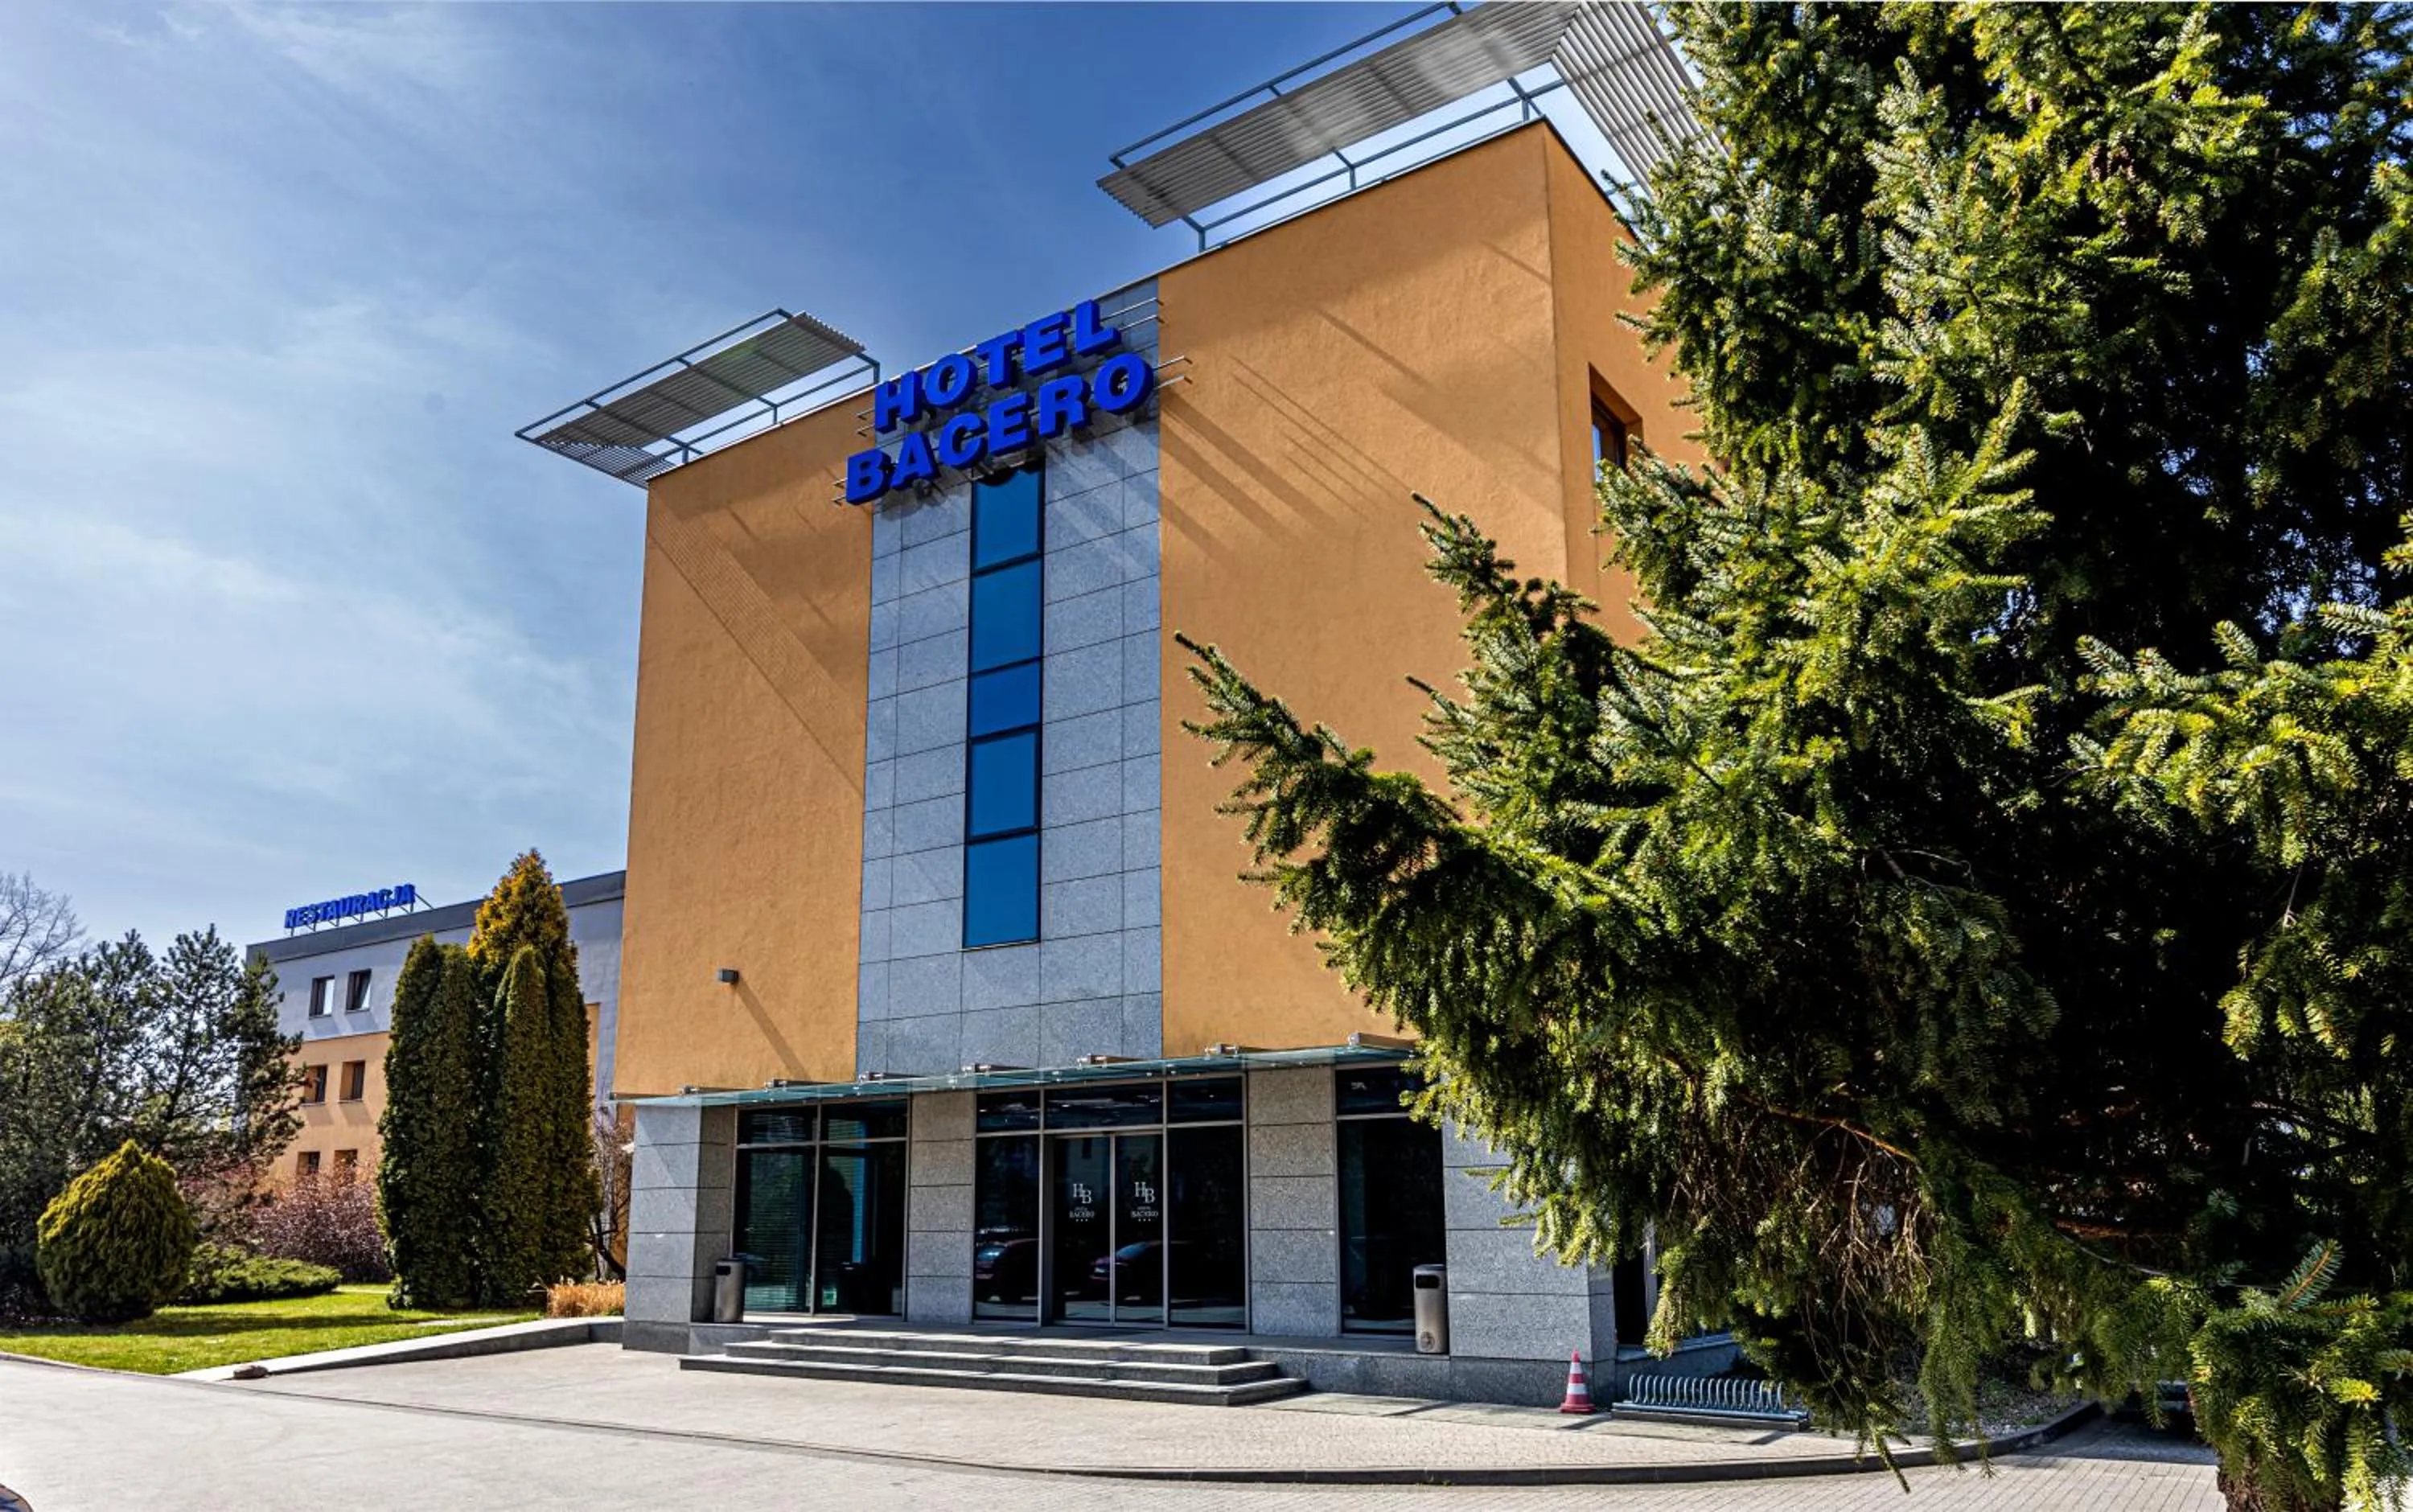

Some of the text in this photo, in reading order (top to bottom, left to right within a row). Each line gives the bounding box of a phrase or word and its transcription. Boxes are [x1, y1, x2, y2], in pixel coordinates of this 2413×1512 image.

[875, 300, 1121, 433] HOTEL
[847, 352, 1155, 505] BACERO
[285, 883, 415, 928] RESTAURACJA
[1072, 1183, 1091, 1204] HB
[1134, 1181, 1155, 1203] HB
